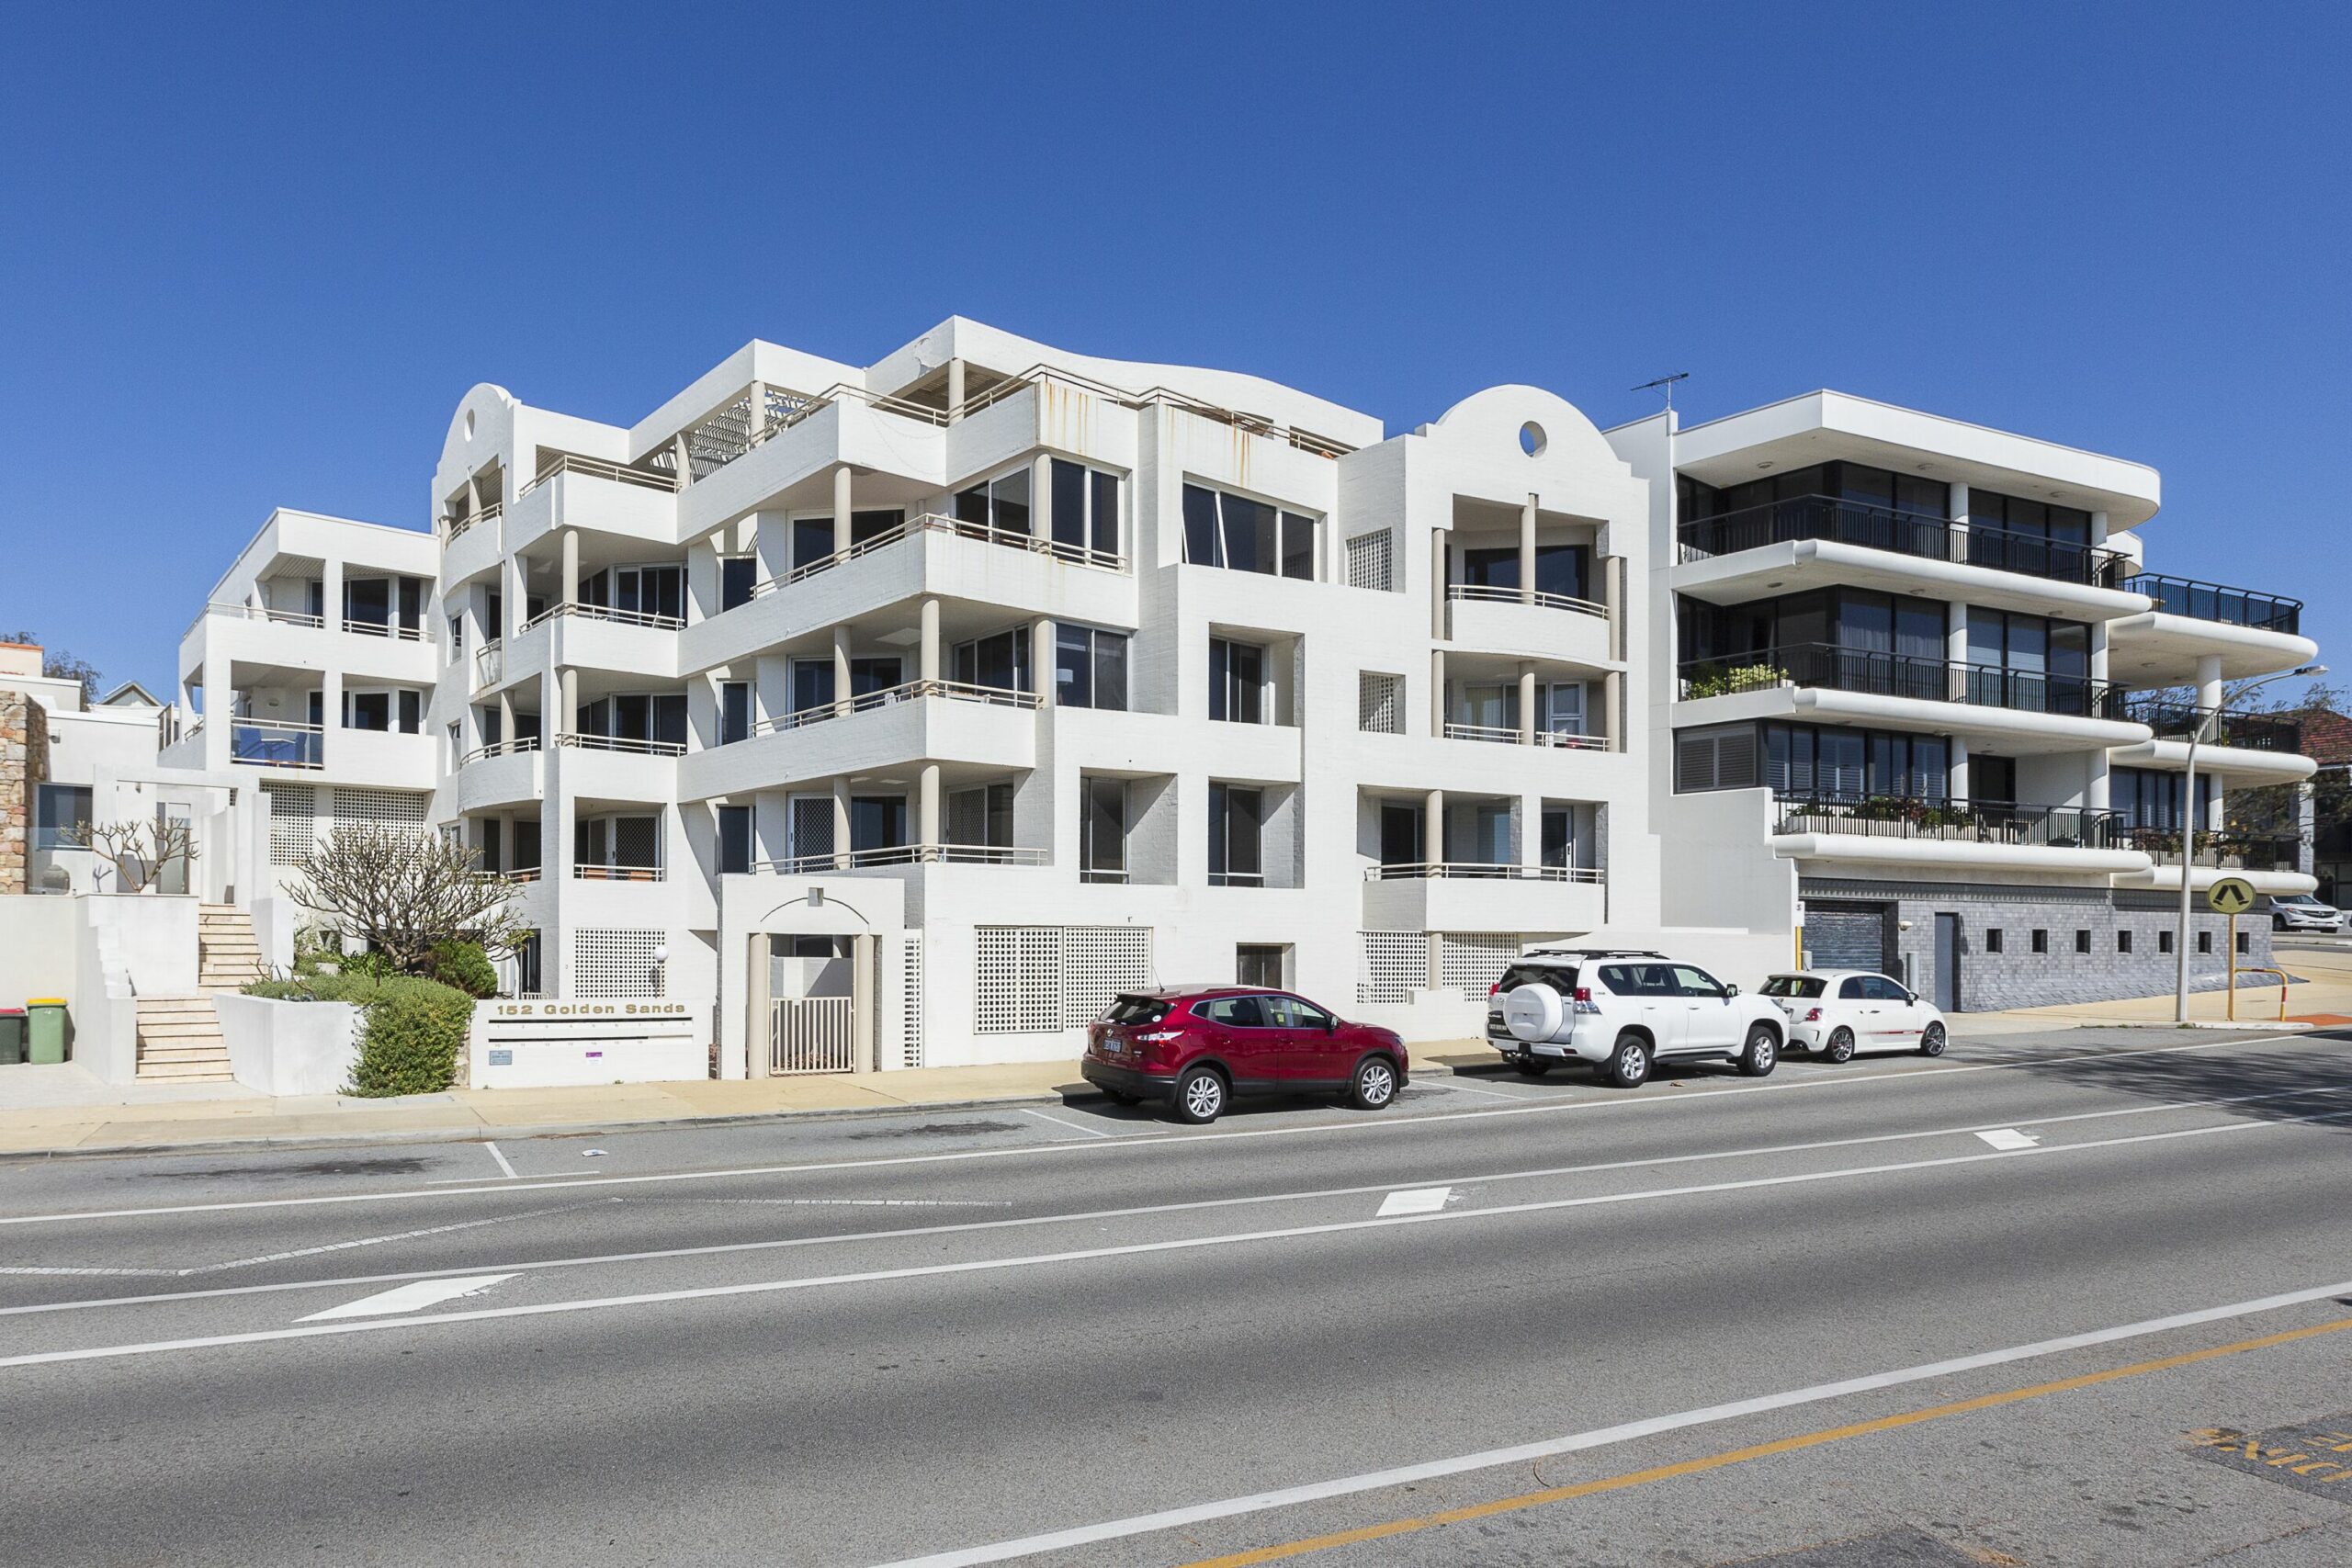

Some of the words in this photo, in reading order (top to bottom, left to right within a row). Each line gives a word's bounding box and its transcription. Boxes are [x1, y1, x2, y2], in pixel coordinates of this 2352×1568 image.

[497, 1005, 533, 1015] 152
[544, 1004, 615, 1015] Golden
[625, 1003, 685, 1014] Sands
